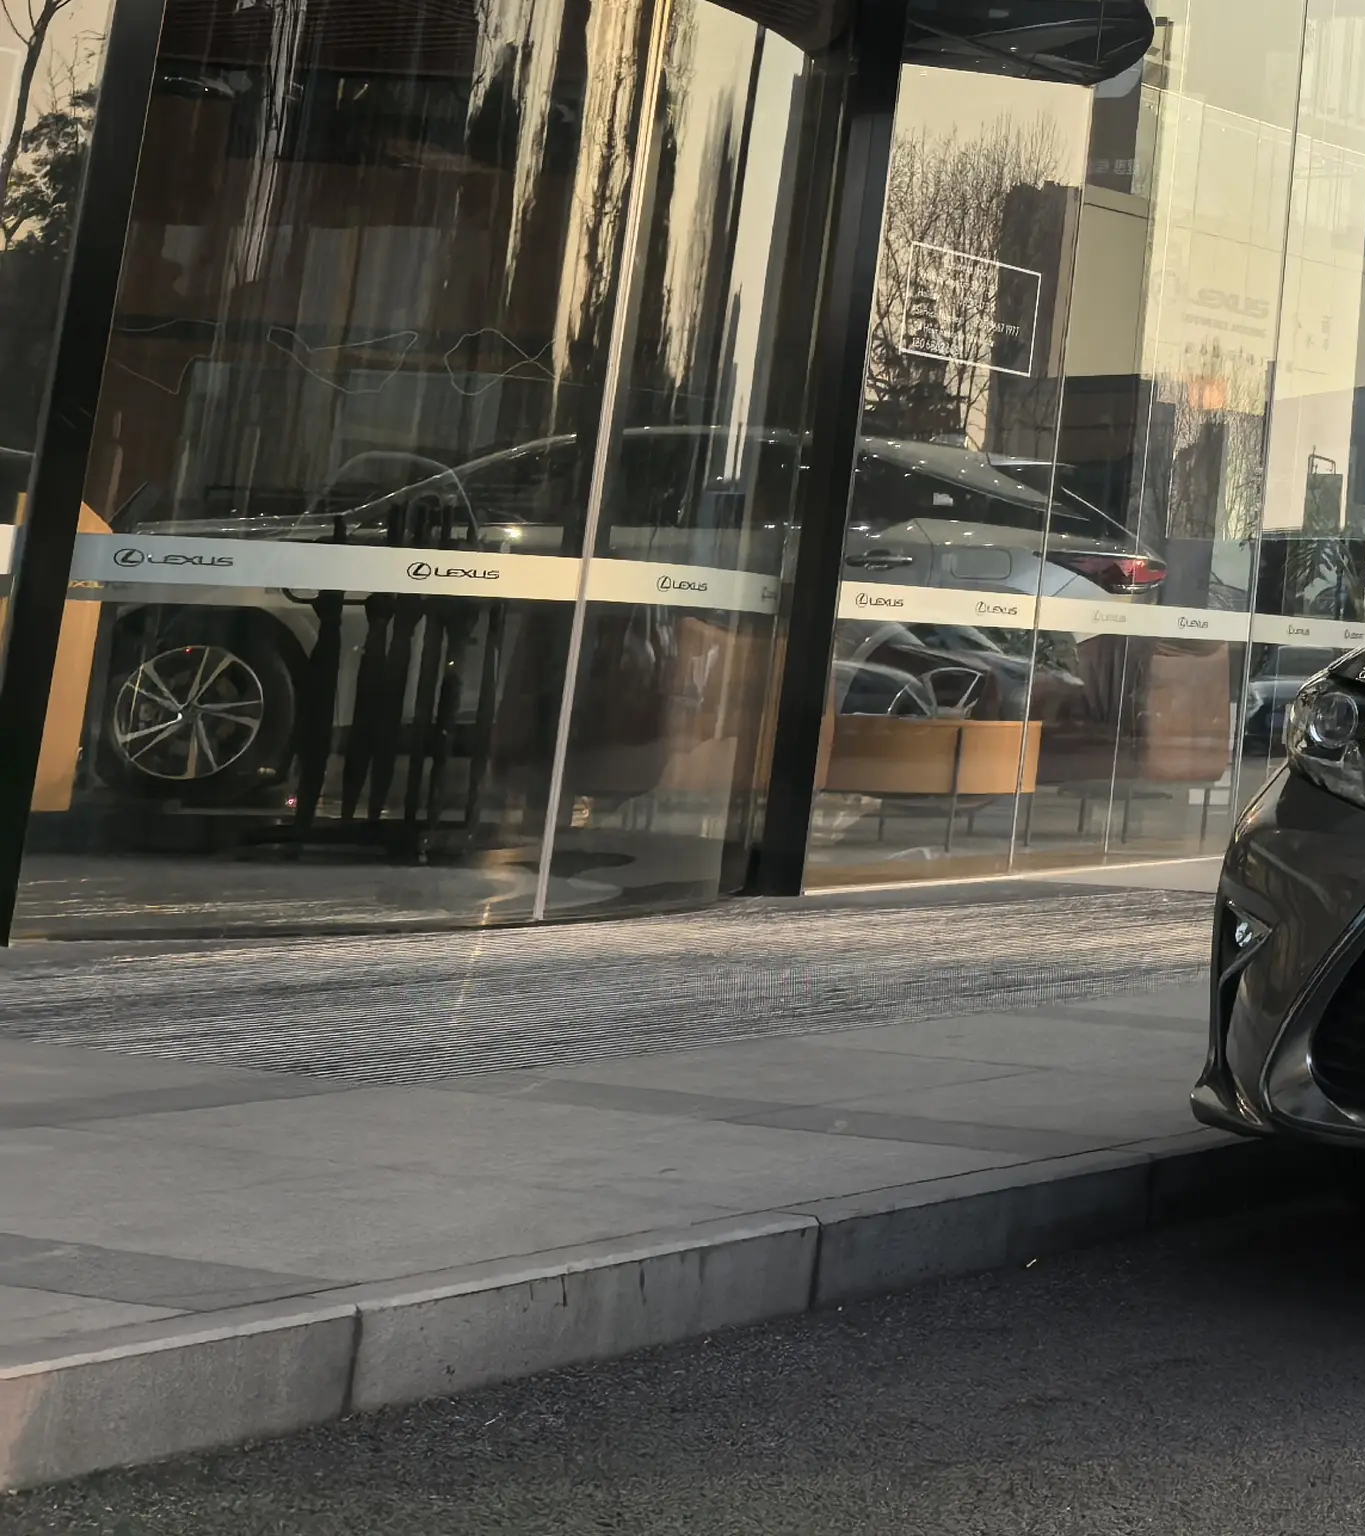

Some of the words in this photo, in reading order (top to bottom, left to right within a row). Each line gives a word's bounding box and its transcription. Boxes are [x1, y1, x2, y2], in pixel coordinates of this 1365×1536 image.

[147, 554, 234, 567] LEXUS
[434, 566, 500, 580] LEXUS
[672, 579, 708, 592] LEXUS
[869, 596, 904, 607] LEXUS
